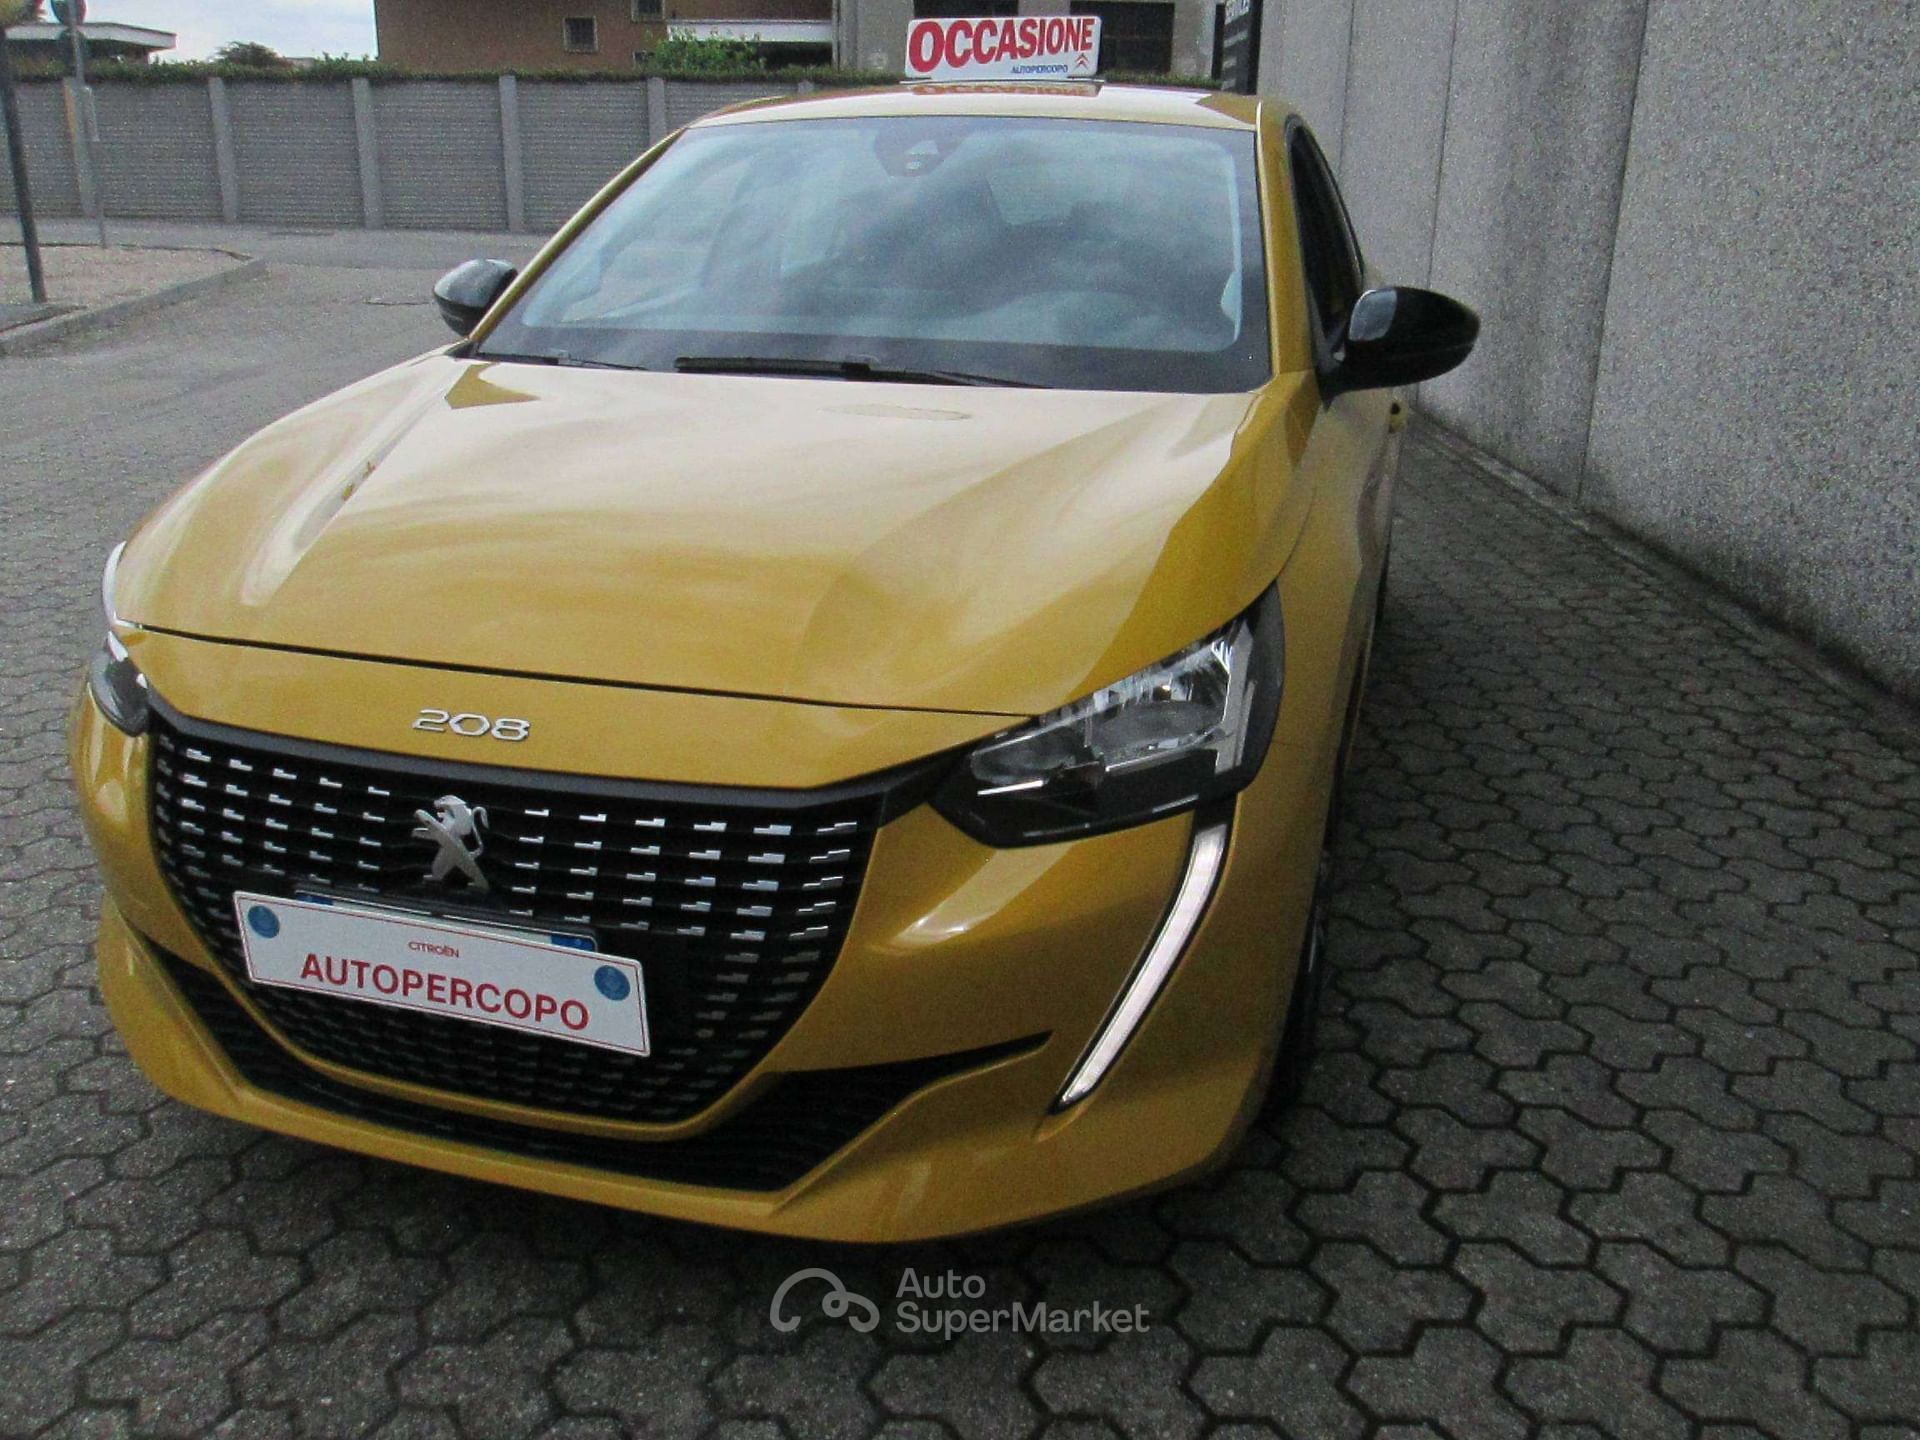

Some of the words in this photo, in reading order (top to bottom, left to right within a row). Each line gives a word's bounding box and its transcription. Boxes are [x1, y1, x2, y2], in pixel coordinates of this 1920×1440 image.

[908, 18, 1096, 73] OCCASIONE
[412, 708, 531, 740] 208
[300, 952, 590, 1031] AUTOPERCOPO
